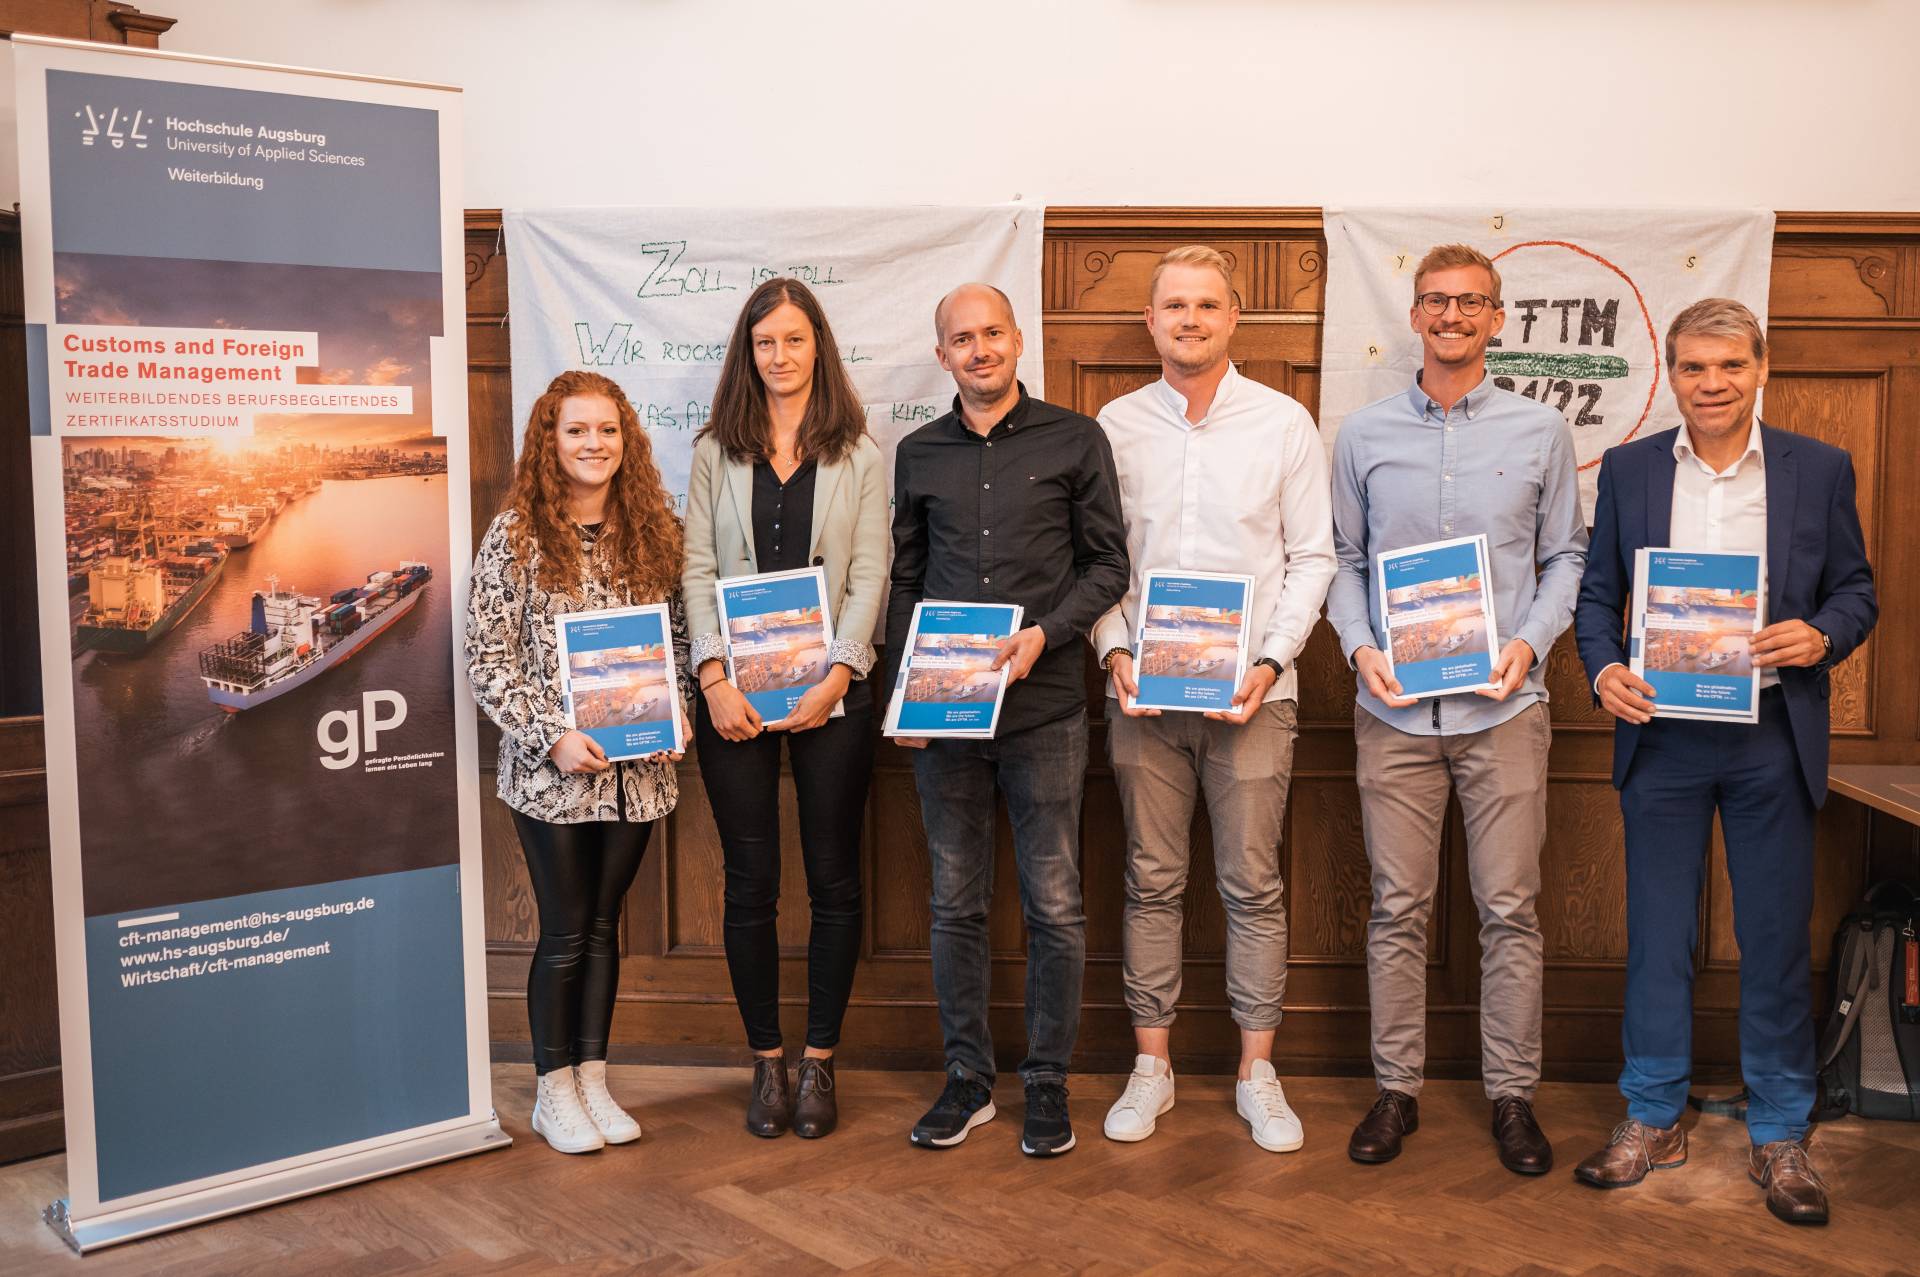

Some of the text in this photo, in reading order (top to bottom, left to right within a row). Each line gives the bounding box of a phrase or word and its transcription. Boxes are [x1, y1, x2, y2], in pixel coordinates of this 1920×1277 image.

[166, 117, 326, 147] Hochschule Augsburg
[167, 136, 366, 167] University of Applied Sciences
[168, 167, 264, 190] Weiterbildung
[1493, 215, 1504, 230] J
[1686, 256, 1697, 269] S
[789, 265, 845, 284] TOLL
[64, 334, 305, 361] Customs and Foreign
[1368, 346, 1378, 357] A
[64, 360, 282, 384] Trade Management
[66, 391, 399, 408] WEITERBILDENDES BERUFSBEGLEITENDES
[66, 415, 239, 428] ZERTIFIKATSSTUDIUM
[317, 690, 408, 770] gP
[365, 751, 444, 766] gefragte Persönlichkeiten
[366, 760, 433, 773] lernen ein Leben lang
[119, 897, 375, 947] cft-management@hs-augsburg.de
[120, 928, 290, 967] www.hs-augsburg.de/
[121, 941, 331, 988] Wirtschaft/cft-management
